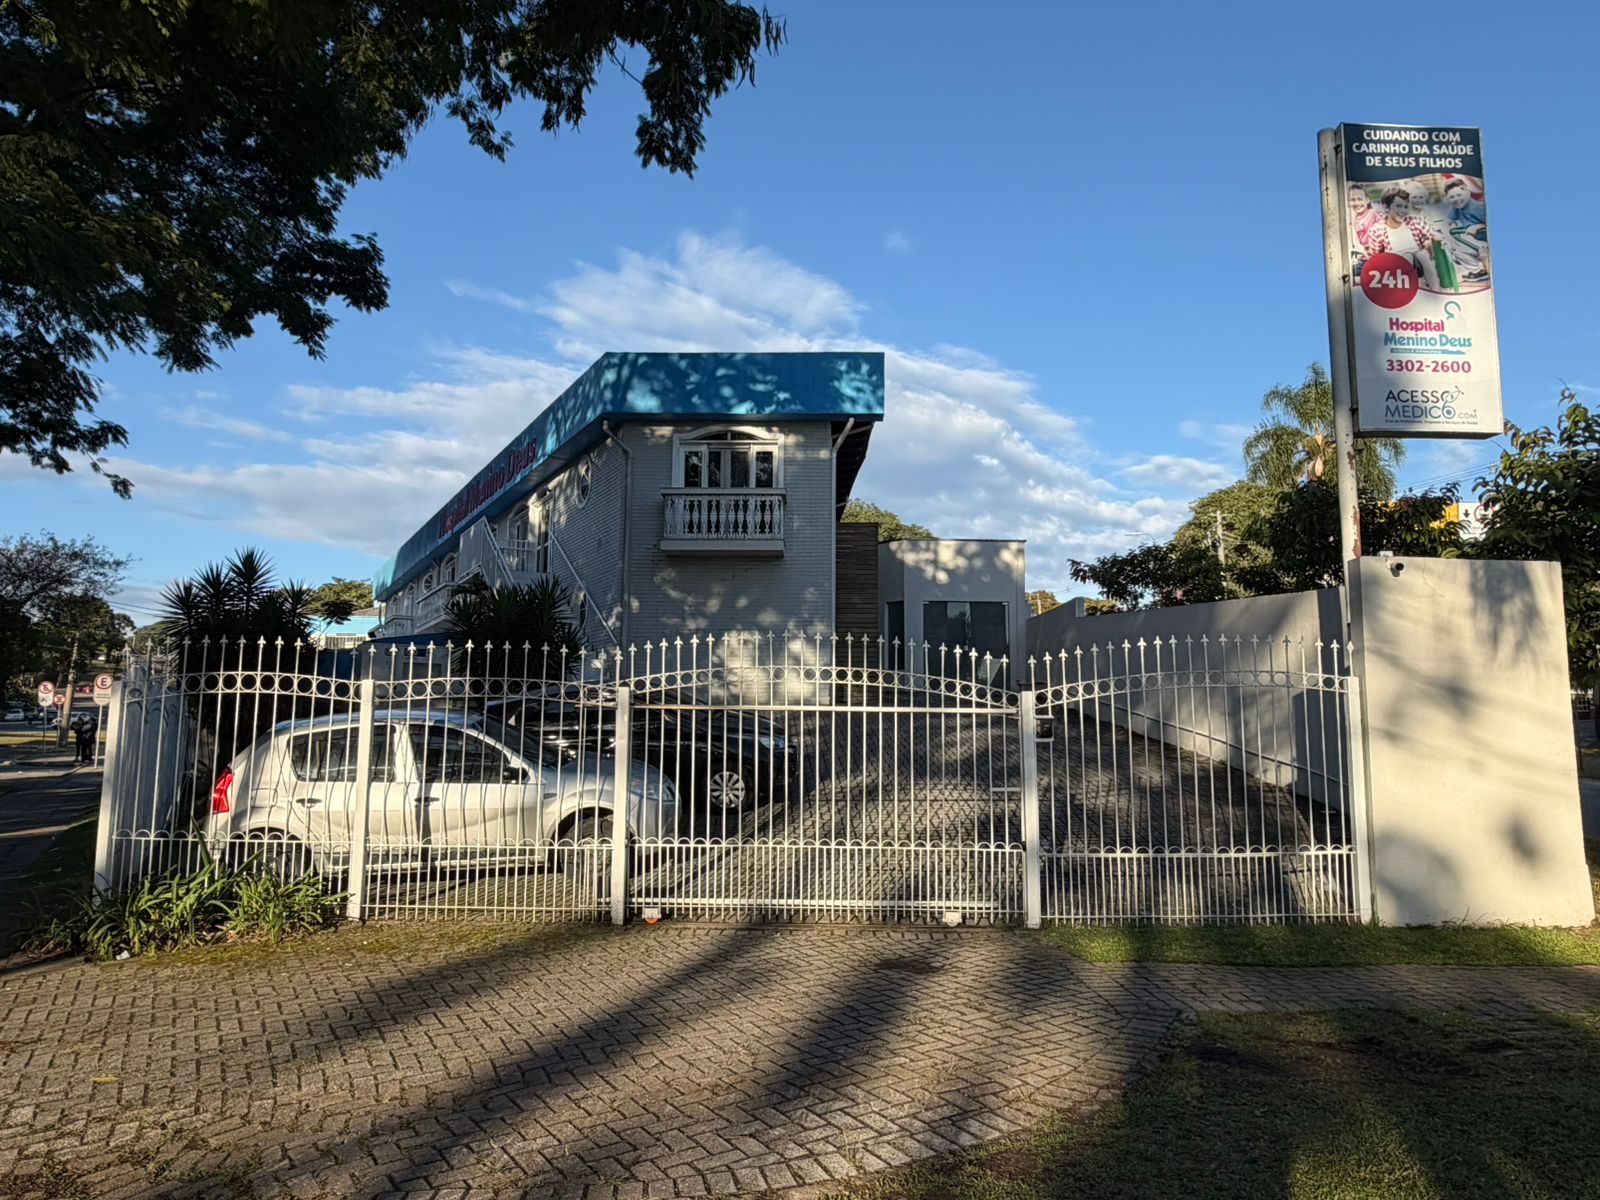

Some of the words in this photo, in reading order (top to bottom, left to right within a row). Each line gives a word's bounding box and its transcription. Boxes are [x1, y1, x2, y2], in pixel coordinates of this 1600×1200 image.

[1363, 129, 1429, 142] CUIDANDO
[1431, 131, 1461, 142] COM
[1352, 142, 1409, 154] CARINHO
[1412, 144, 1430, 155] DA
[1432, 140, 1474, 156] SAÚDE
[1365, 156, 1382, 167] DE
[1384, 156, 1416, 168] SEUS
[1419, 157, 1463, 169] FILHOS
[1368, 269, 1411, 289] 24h
[1389, 317, 1445, 332] Hospital
[1383, 332, 1437, 347] Menino
[1439, 334, 1472, 348] Deus
[1386, 359, 1472, 374] 3302-2600
[1385, 389, 1454, 404] ACESSO
